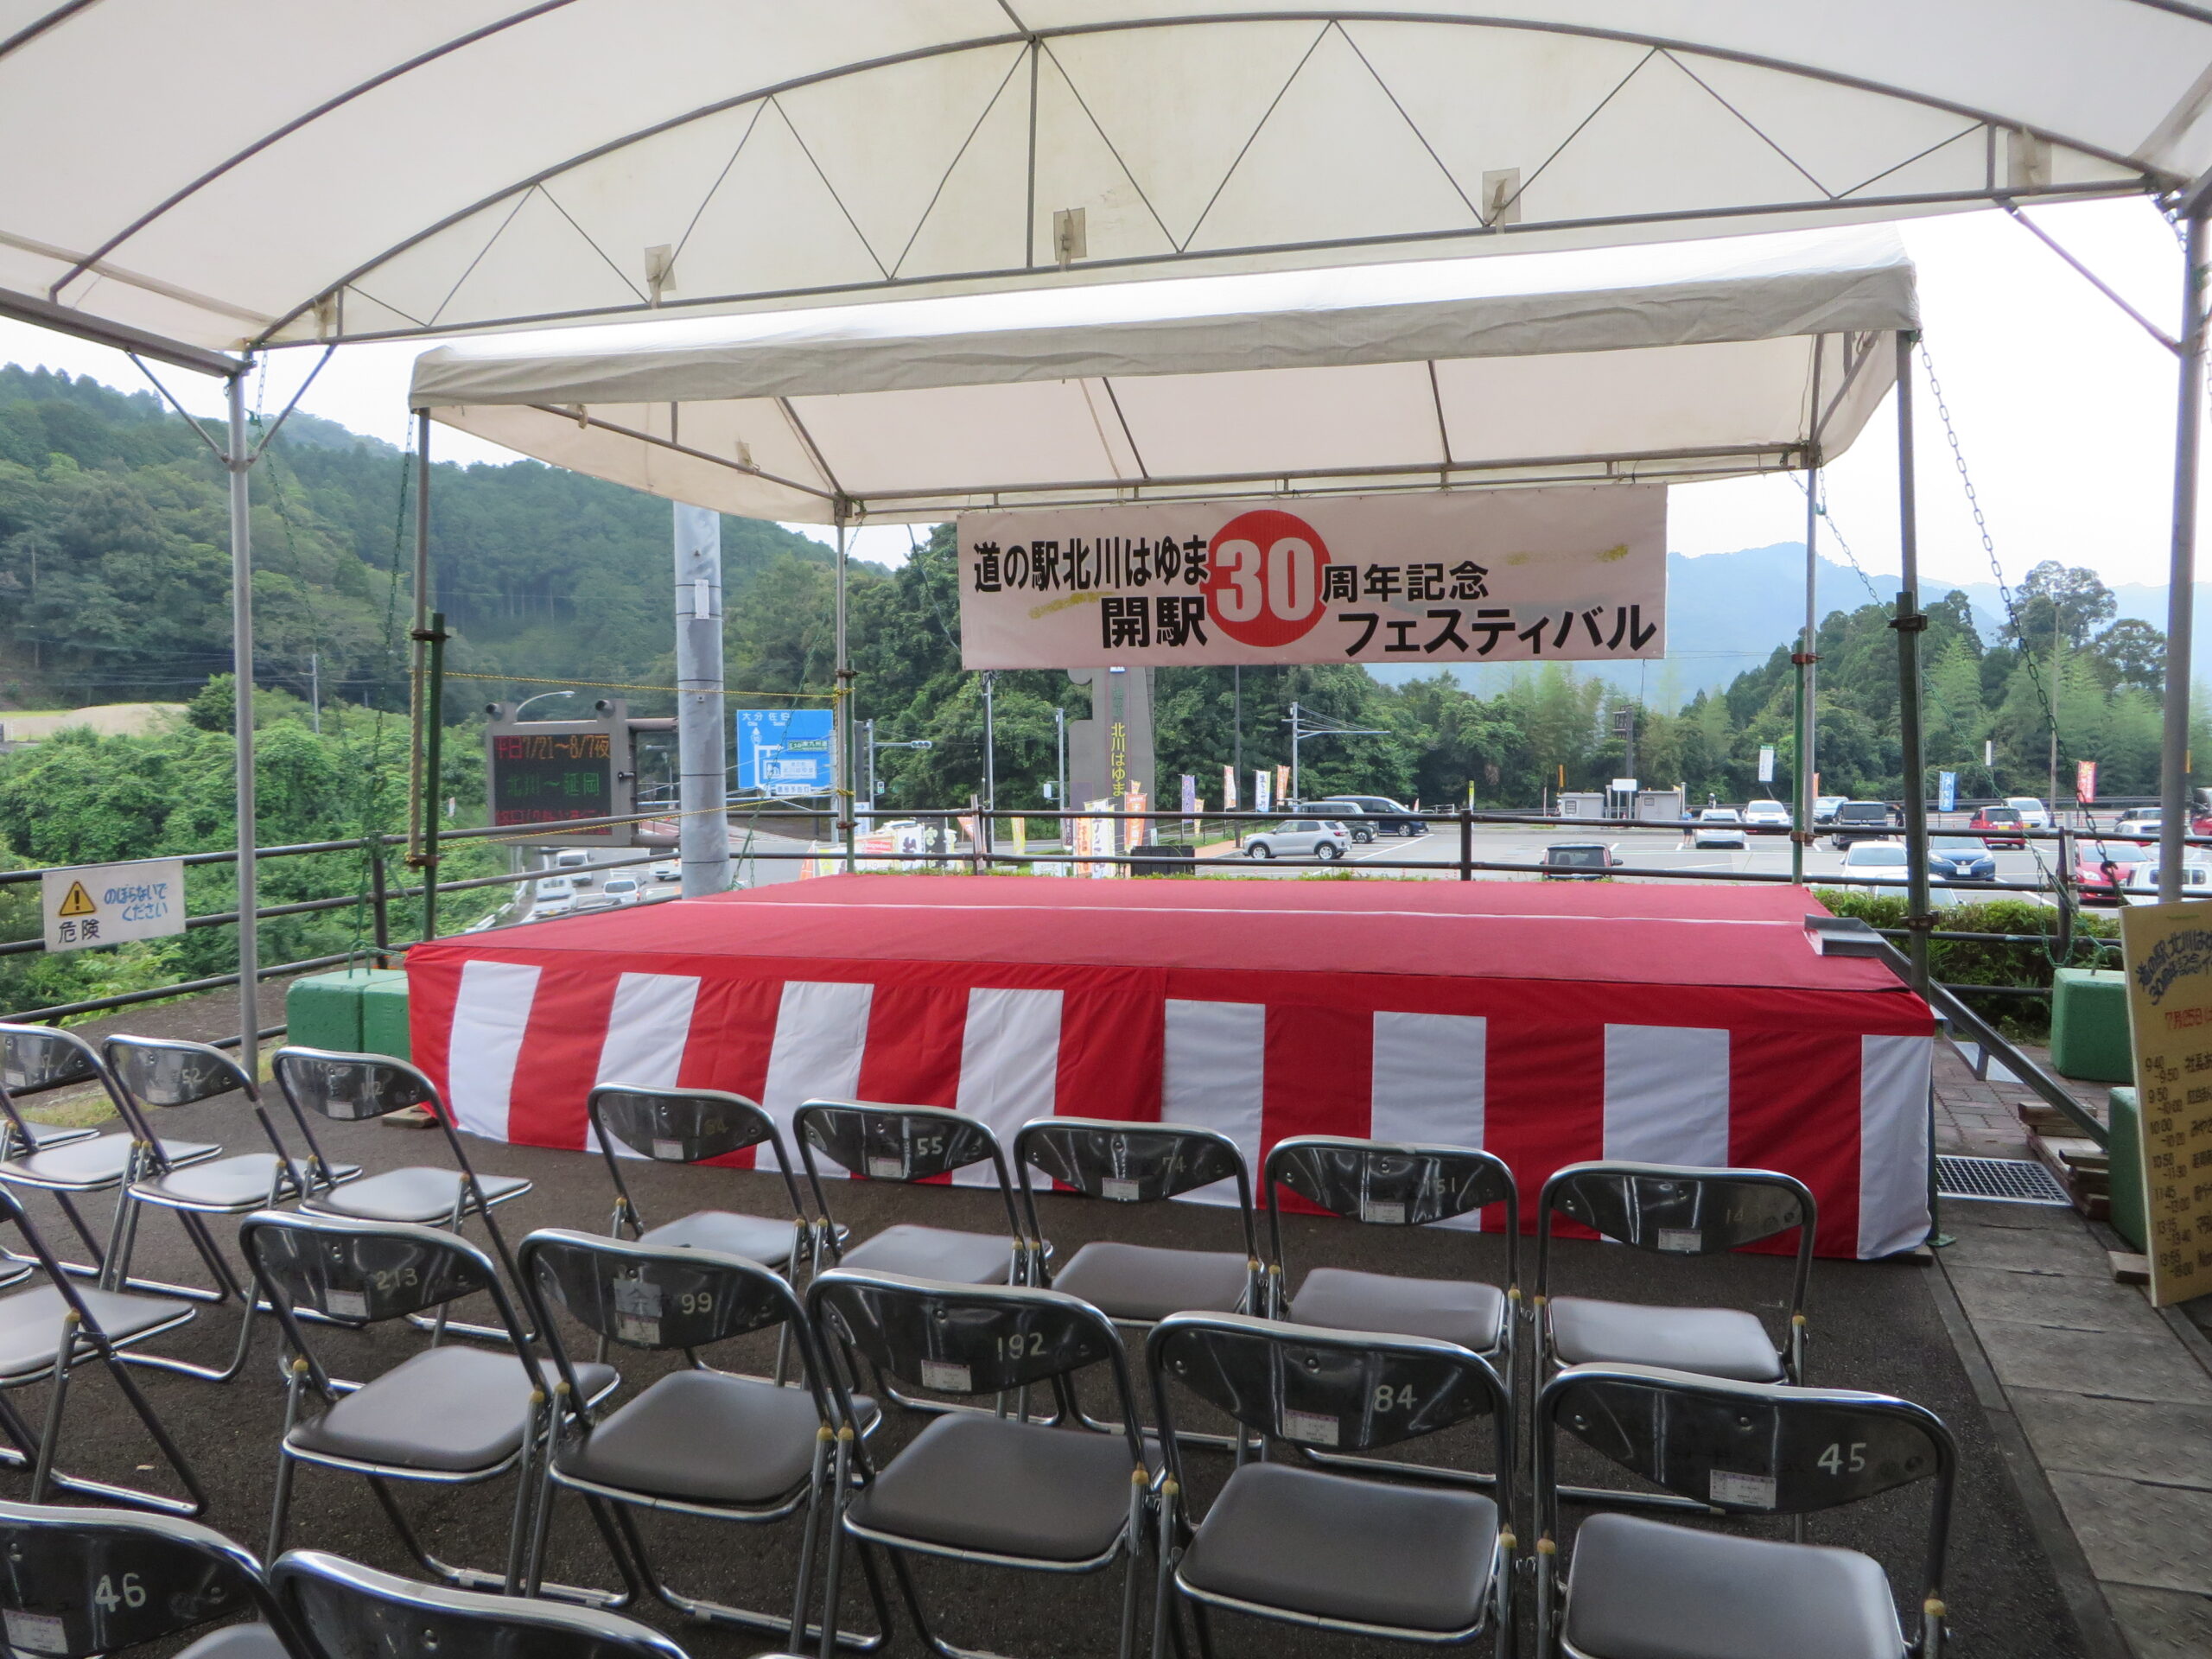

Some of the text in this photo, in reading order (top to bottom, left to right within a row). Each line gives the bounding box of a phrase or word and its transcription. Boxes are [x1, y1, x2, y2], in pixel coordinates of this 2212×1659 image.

[974, 535, 1490, 623] 道の駅北川はゆま 30 周年記念
[1102, 595, 1208, 649] 開駅
[1338, 603, 1656, 657] フェスティバル
[1110, 722, 1127, 797] 北川はゆま
[104, 882, 168, 906] のぼらないで
[121, 902, 168, 922] ください
[58, 918, 101, 944] 危険
[181, 1067, 203, 1084] 52
[917, 1136, 944, 1155] 55
[1162, 1155, 1187, 1173] 74
[377, 1268, 419, 1291] 213
[681, 1292, 713, 1314] 99
[997, 1332, 1048, 1363] 192
[1374, 1383, 1418, 1413] 84
[1817, 1442, 1867, 1476] 45
[94, 1572, 146, 1613] 46
